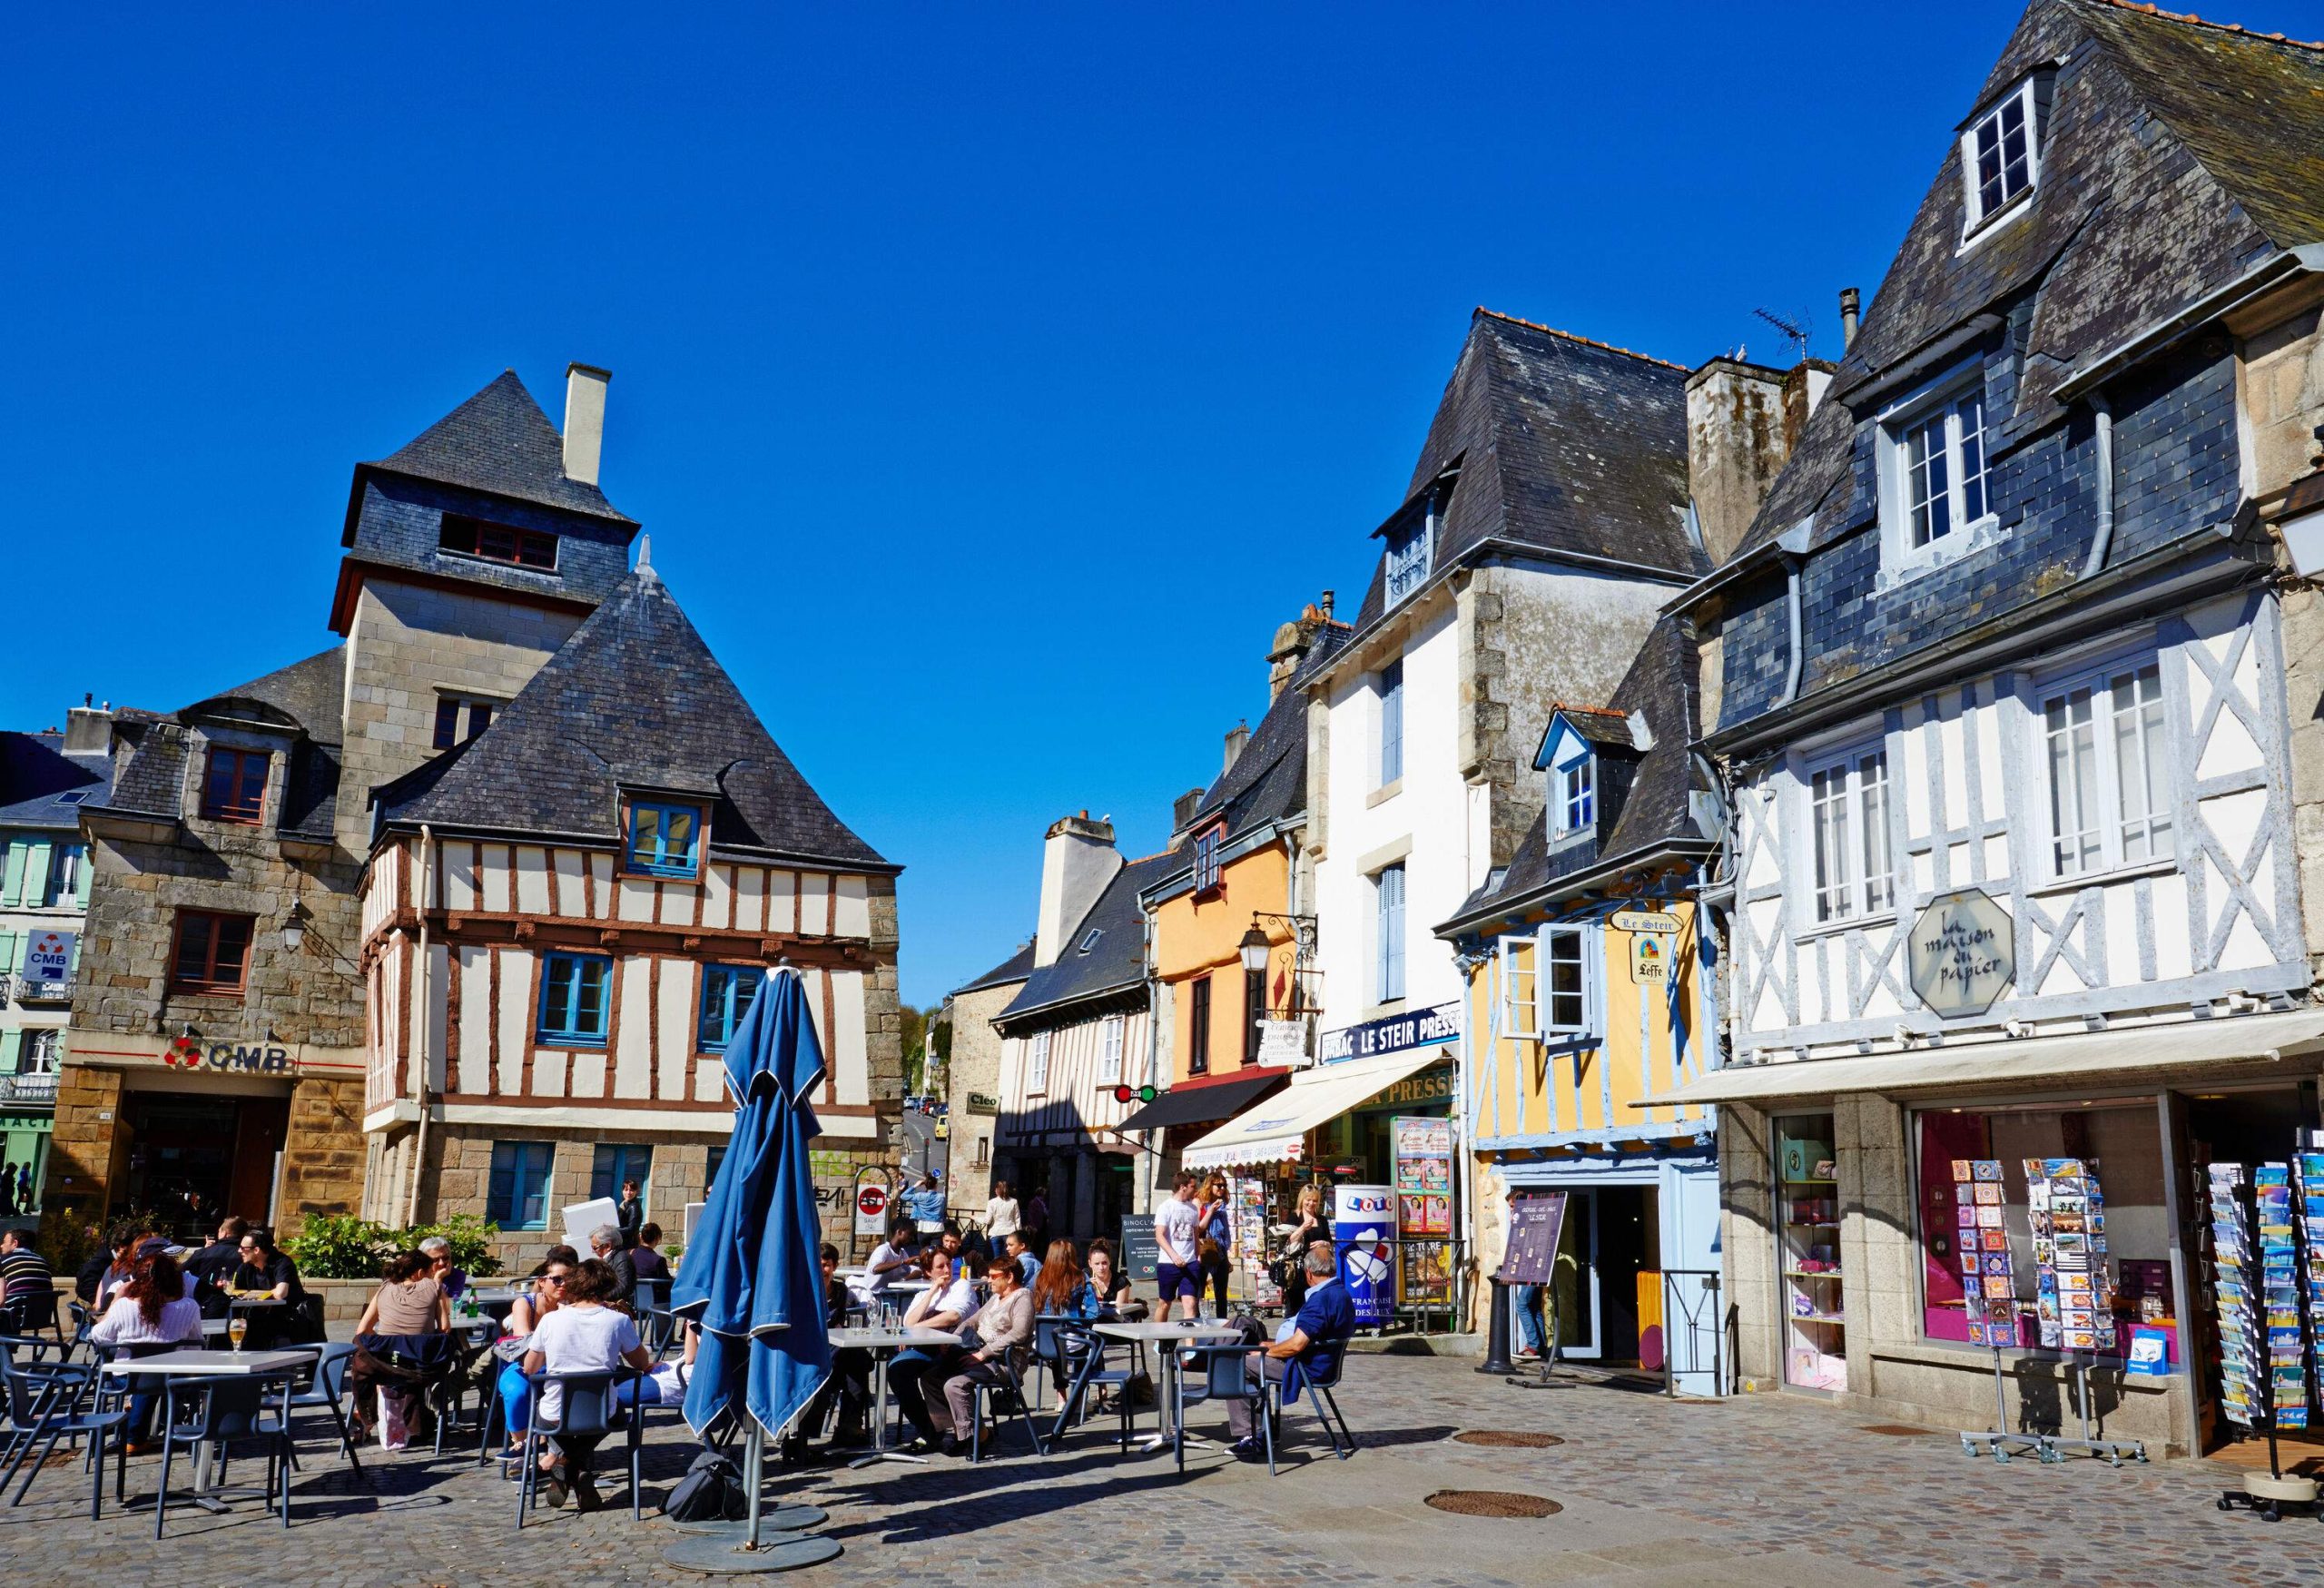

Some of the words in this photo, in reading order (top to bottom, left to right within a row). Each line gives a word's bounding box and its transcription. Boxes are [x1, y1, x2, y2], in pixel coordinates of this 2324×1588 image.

[1620, 918, 1638, 928] Le
[1641, 920, 1674, 930] Steir
[1941, 910, 1965, 934] la
[1925, 928, 1994, 953] maison
[31, 952, 67, 965] CMB
[1954, 948, 1973, 964] du
[1638, 963, 1663, 978] Leffe
[1940, 957, 2002, 996] papier
[1362, 1031, 1375, 1054] LE
[1379, 1021, 1415, 1050] STEIR
[209, 1045, 287, 1070] CMB
[970, 1094, 997, 1106] Cléo
[1347, 1196, 1394, 1212] LOTO
[1355, 1308, 1372, 1317] DES
